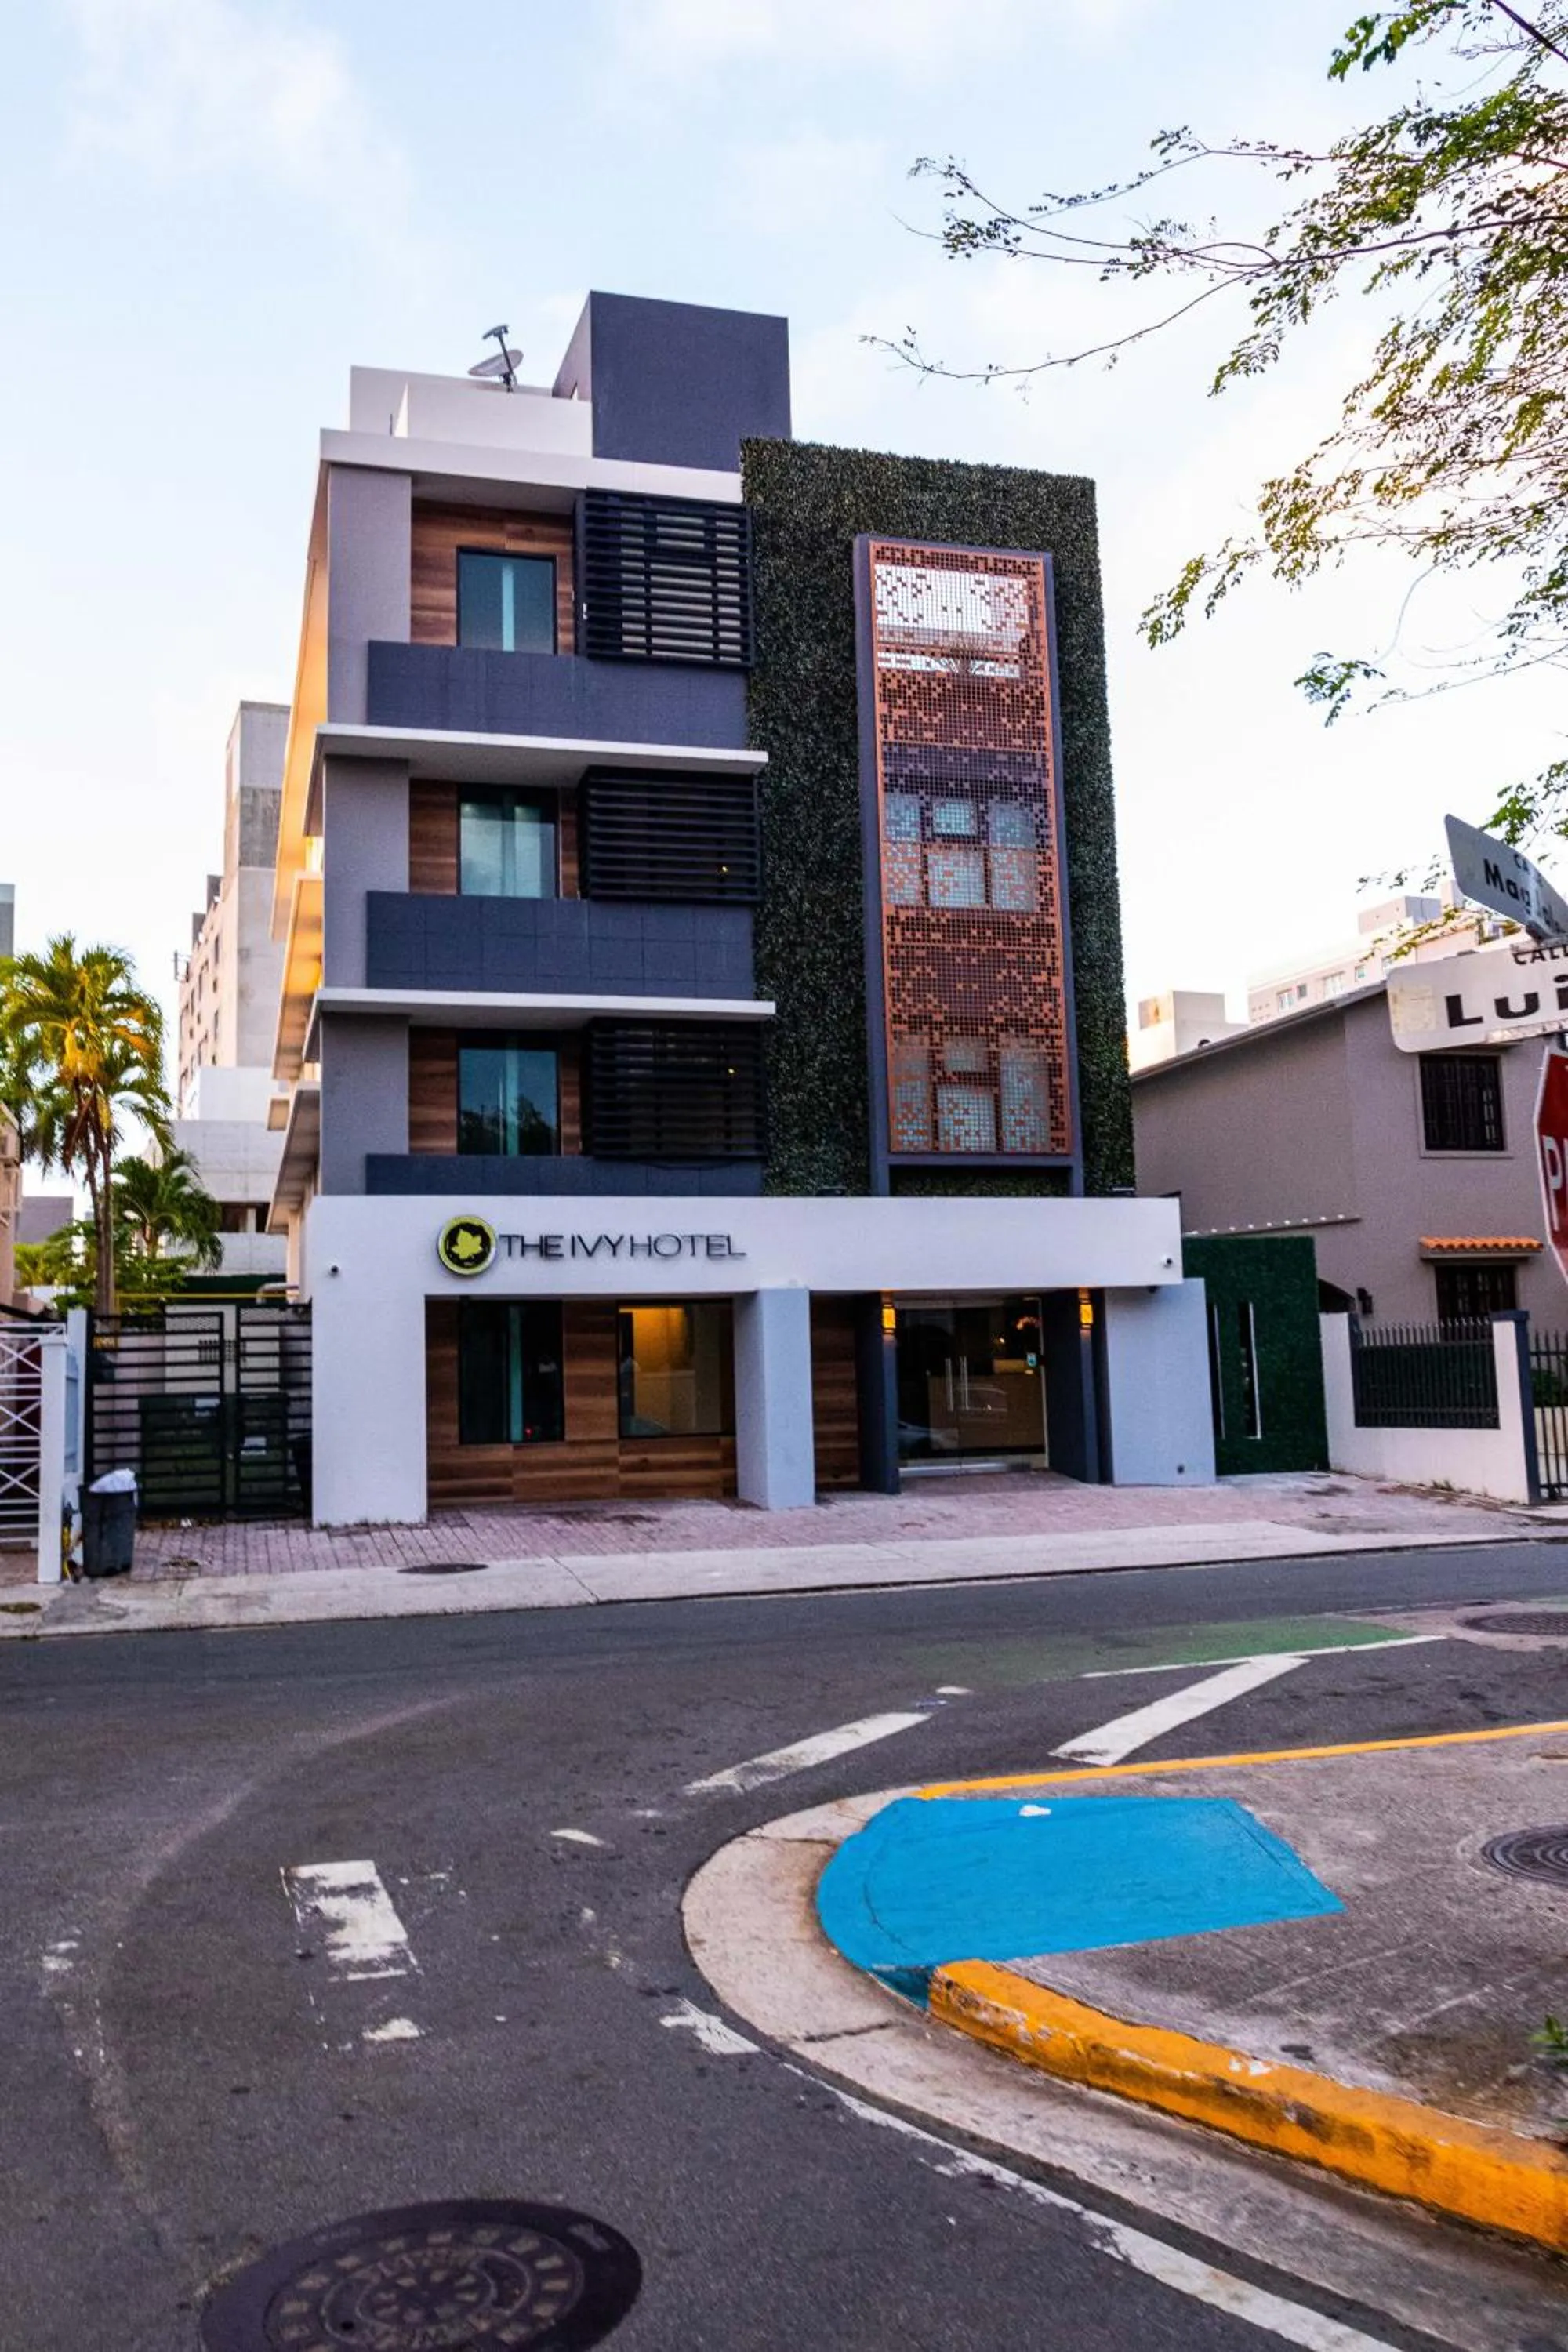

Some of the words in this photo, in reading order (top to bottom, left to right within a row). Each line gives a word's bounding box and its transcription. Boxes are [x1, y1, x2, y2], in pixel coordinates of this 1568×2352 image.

[499, 1234, 564, 1258] THE
[572, 1234, 624, 1258] IVY
[630, 1234, 746, 1258] HOTEL
